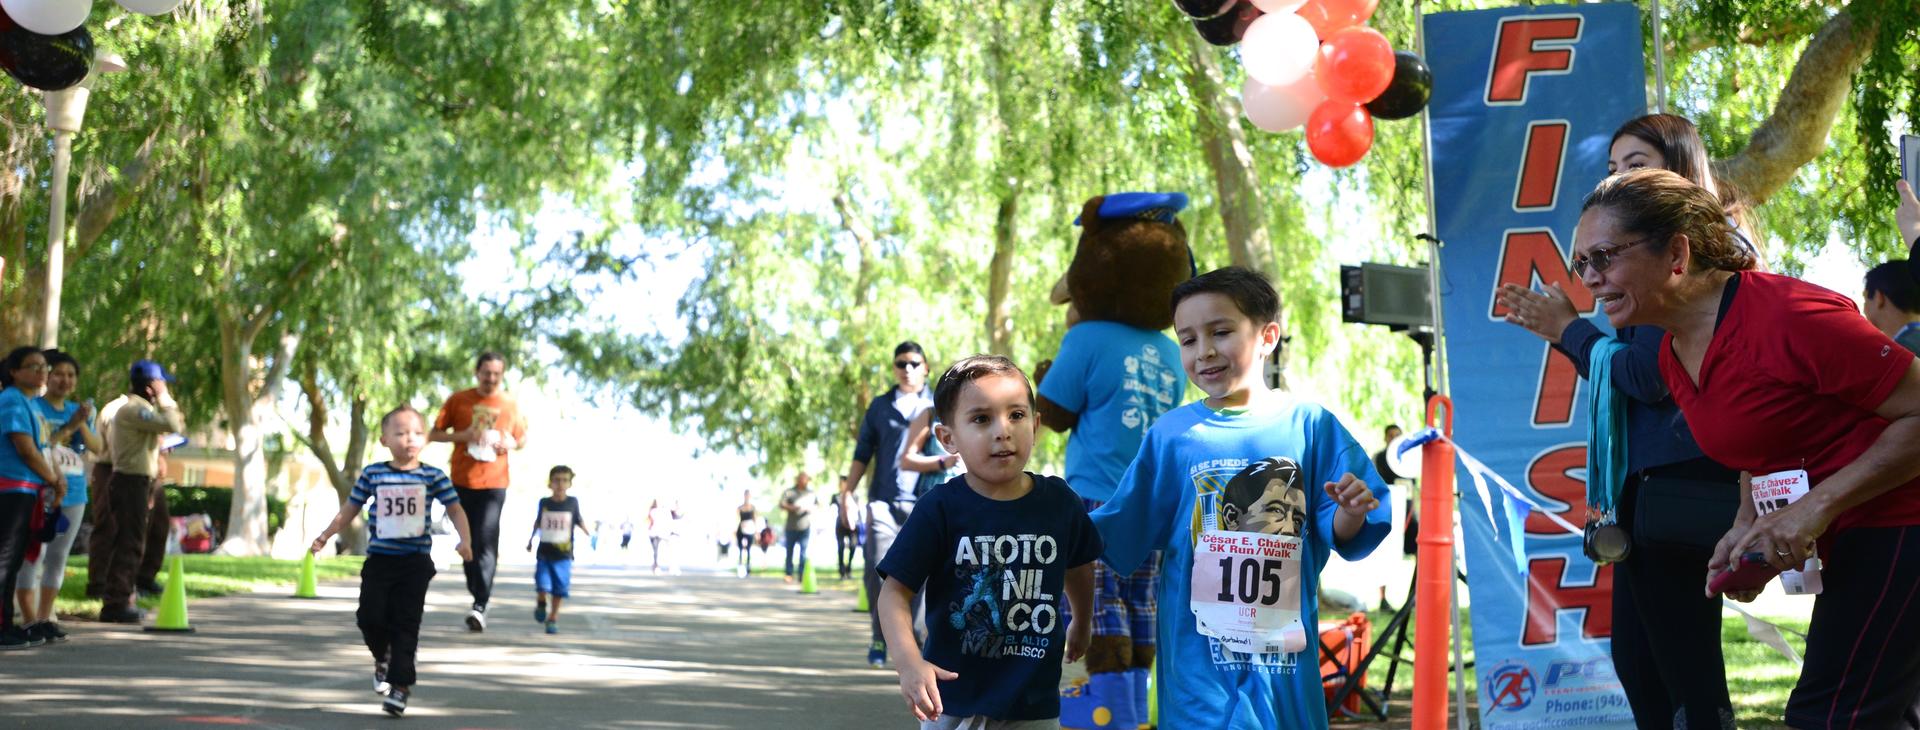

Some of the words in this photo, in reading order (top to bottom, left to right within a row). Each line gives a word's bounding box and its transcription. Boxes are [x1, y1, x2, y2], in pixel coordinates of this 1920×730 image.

[1198, 461, 1210, 470] SE
[1212, 458, 1249, 468] PUEDE
[384, 497, 417, 517] 356
[1209, 543, 1226, 553] 5K
[1242, 537, 1253, 546] E.
[955, 534, 1058, 566] ATOTO
[1002, 569, 1054, 601] NIL
[1217, 556, 1283, 606] 105
[1007, 602, 1057, 635] CO
[1238, 607, 1257, 618] UCR
[1005, 635, 1017, 645] EL
[1022, 635, 1049, 648] ALTO
[1002, 645, 1046, 659] JALISCO
[1546, 698, 1593, 714] Phone:
